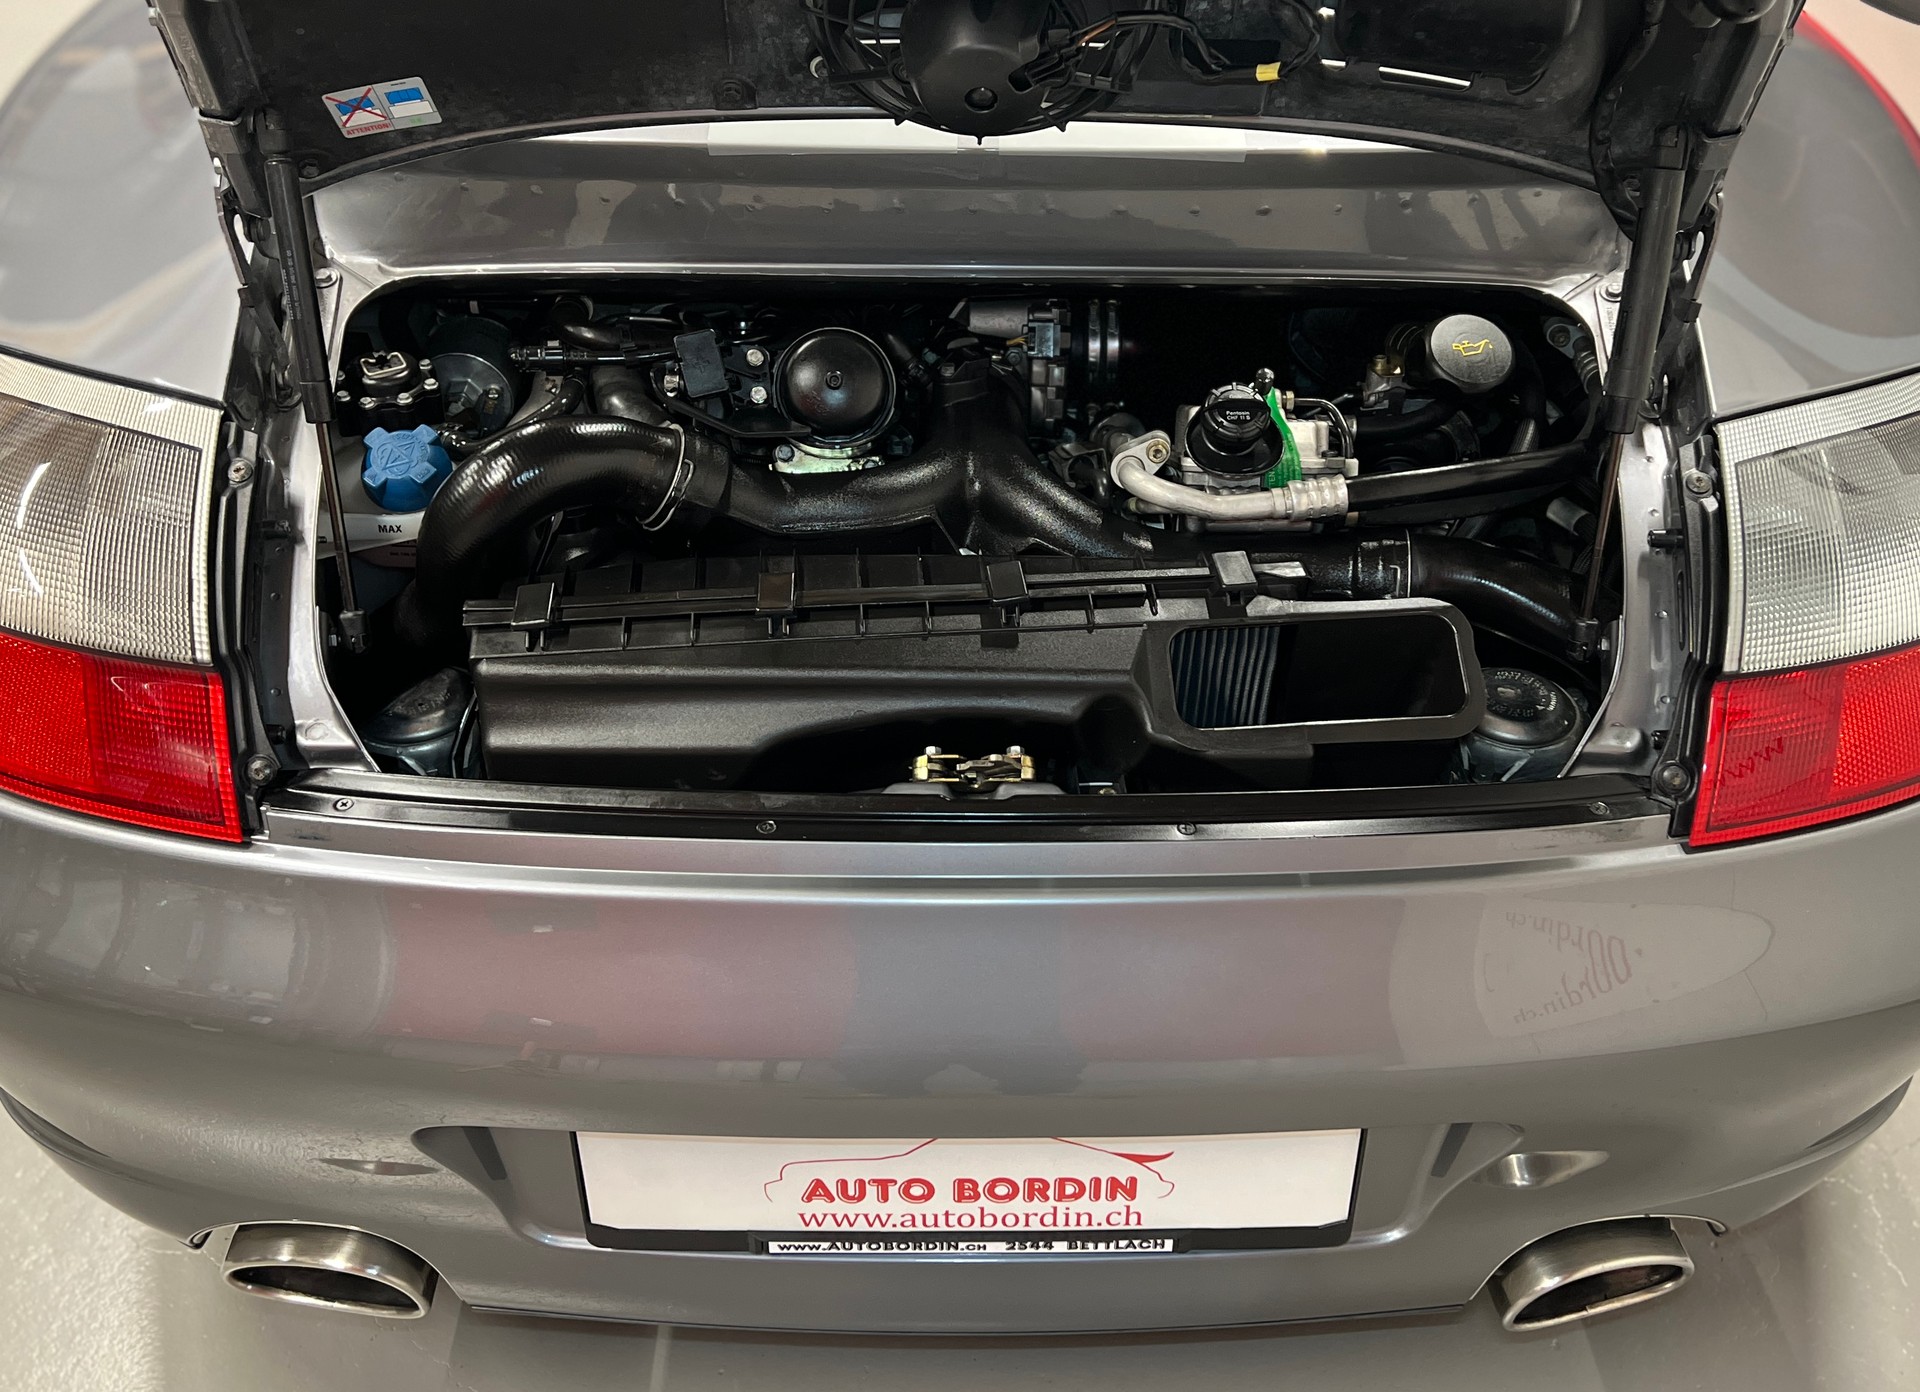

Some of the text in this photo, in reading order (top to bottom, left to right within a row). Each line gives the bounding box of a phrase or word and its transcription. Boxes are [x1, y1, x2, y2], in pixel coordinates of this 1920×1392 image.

[377, 524, 403, 534] MAX
[801, 1176, 1139, 1204] AUTO BORDIN
[798, 1204, 1143, 1229] www.autobordin.ch
[1005, 1241, 1055, 1251] 2544
[1066, 1239, 1166, 1251] BETTLACH
